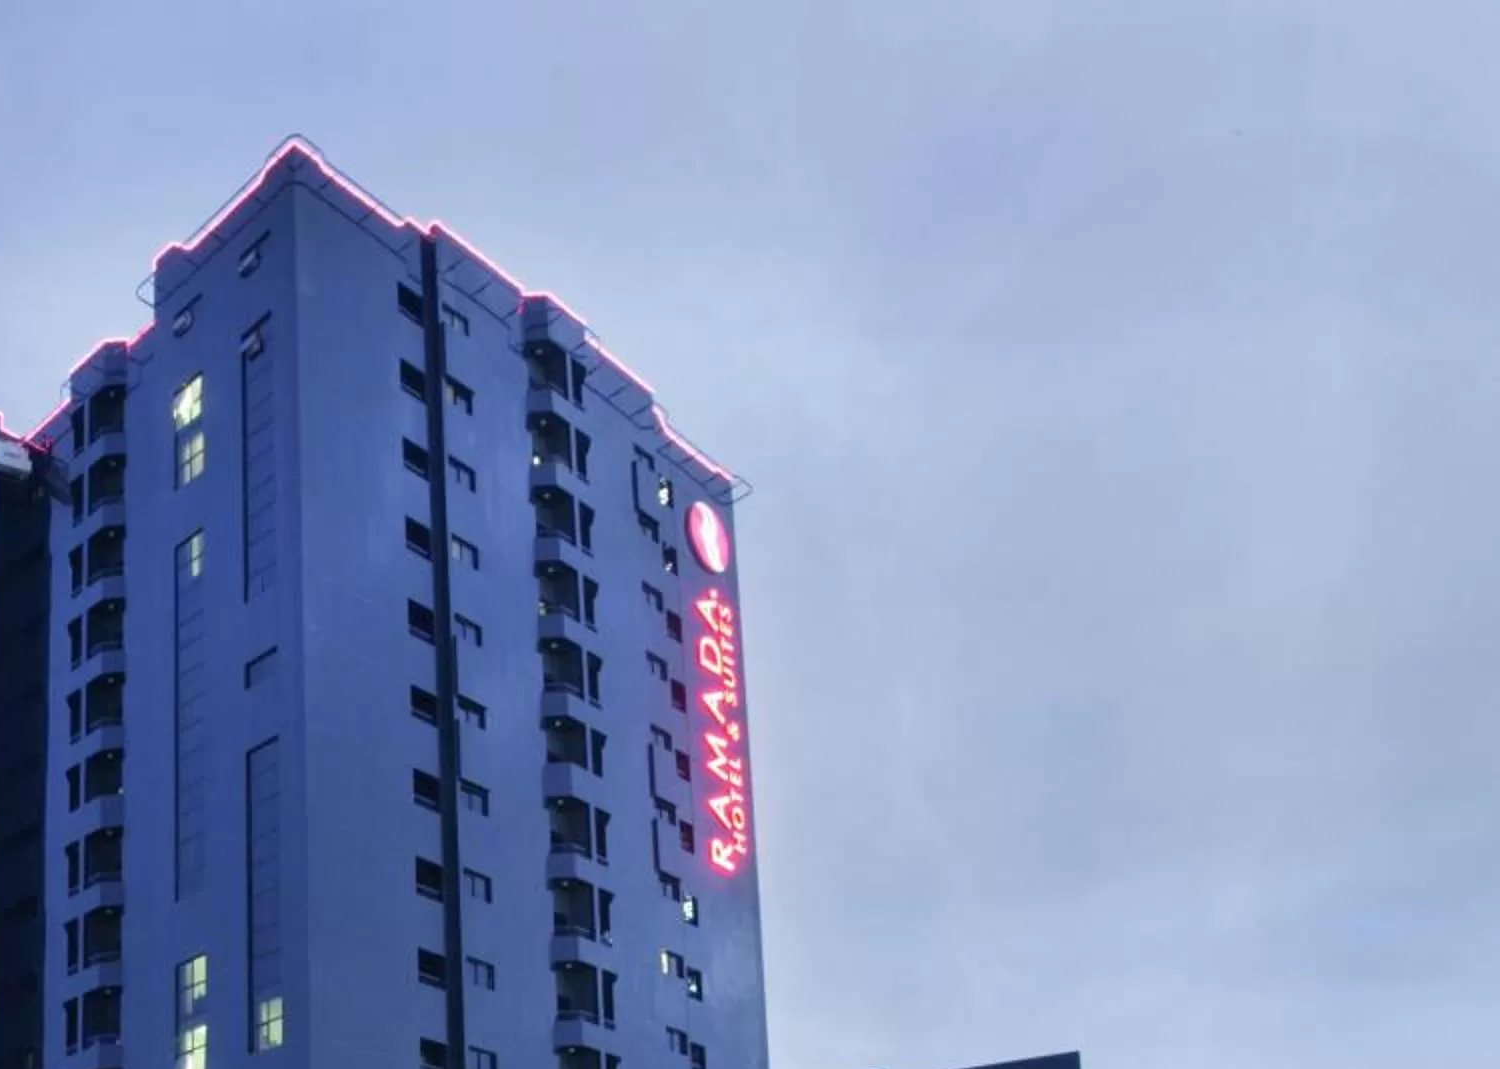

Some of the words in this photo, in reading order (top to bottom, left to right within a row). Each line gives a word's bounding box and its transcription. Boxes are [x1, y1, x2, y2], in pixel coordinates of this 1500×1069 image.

[718, 604, 738, 708] SUITES
[695, 600, 737, 872] RAMADA
[726, 720, 741, 742] &
[728, 757, 748, 855] HOTEL
